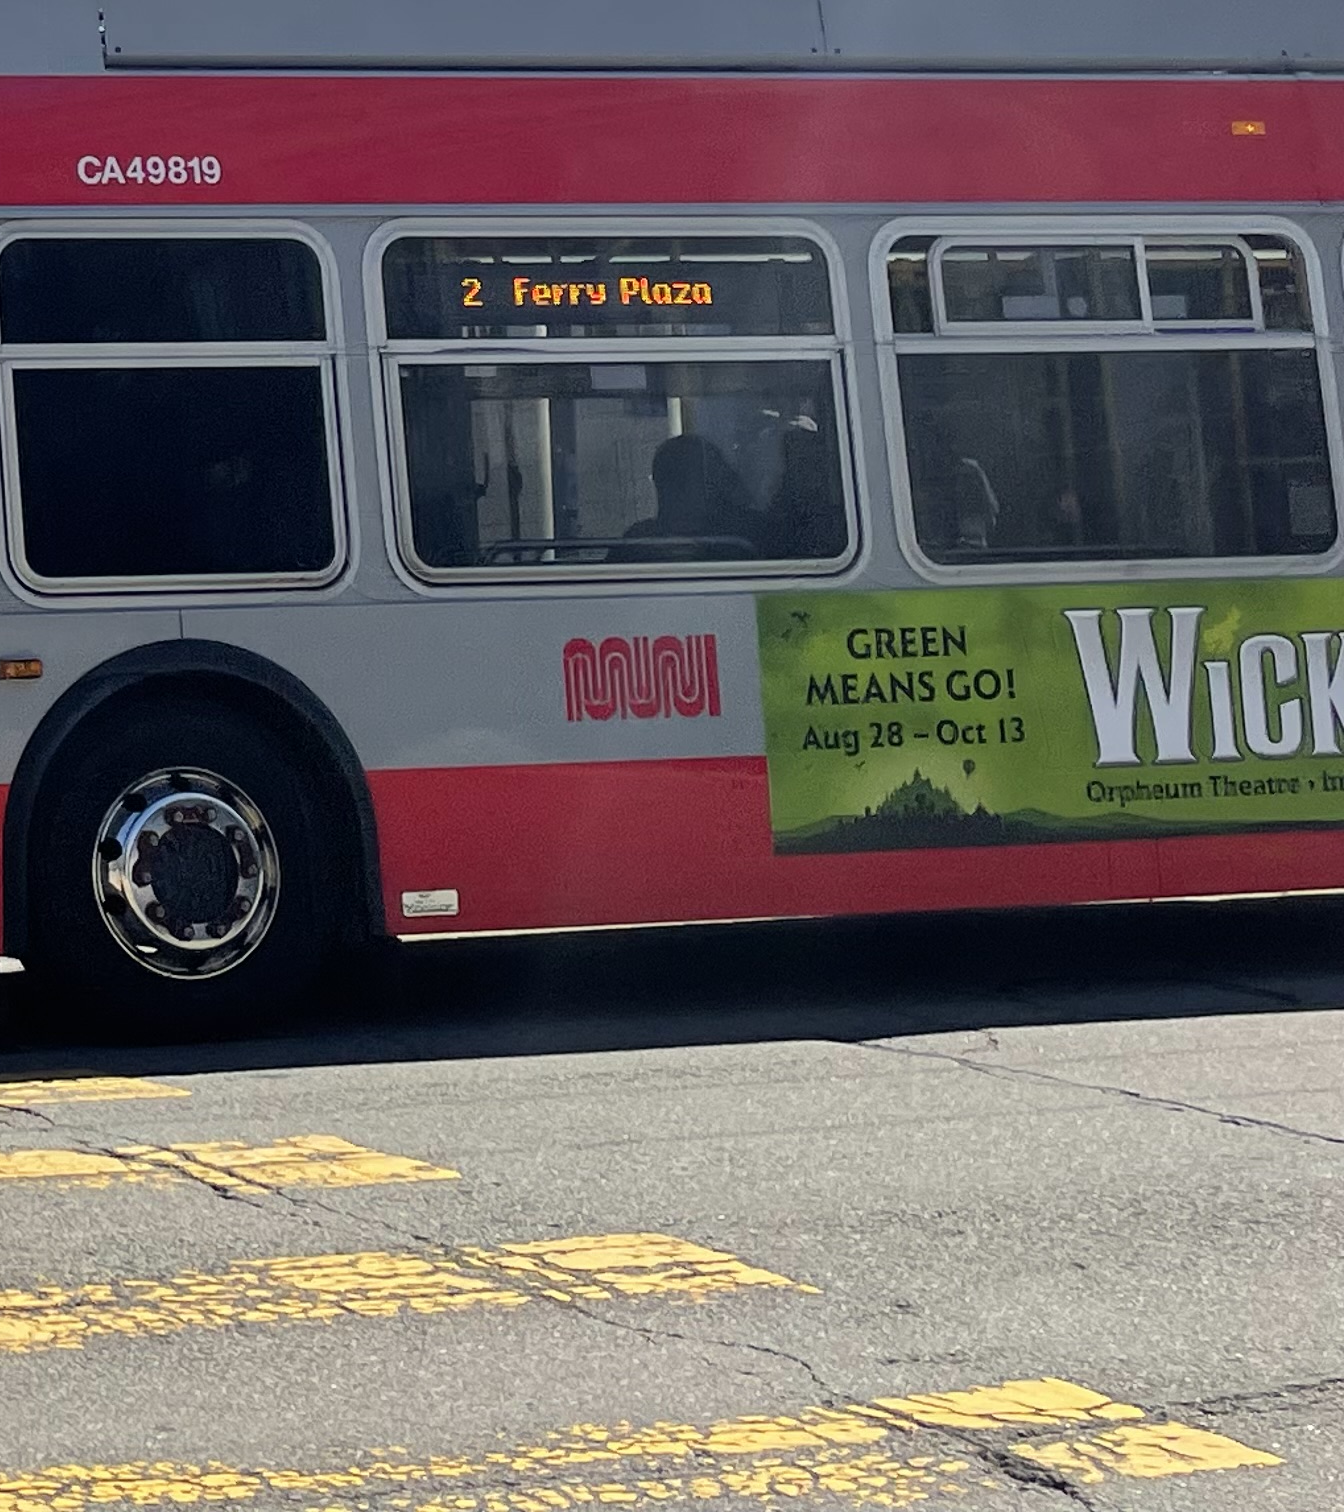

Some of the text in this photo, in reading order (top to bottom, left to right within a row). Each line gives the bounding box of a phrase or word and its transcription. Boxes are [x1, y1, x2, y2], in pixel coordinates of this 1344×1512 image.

[76, 155, 221, 185] CA49819
[461, 277, 712, 307] 2 Ferry Plaza
[846, 624, 968, 660] GREEN
[806, 668, 1016, 706] MEANS GO!
[802, 725, 860, 756] Aug
[869, 721, 904, 748] 28
[936, 719, 987, 745] Oct
[999, 717, 1026, 743] 13
[1086, 779, 1203, 807] Orpheum
[1209, 774, 1300, 797] Theatre
